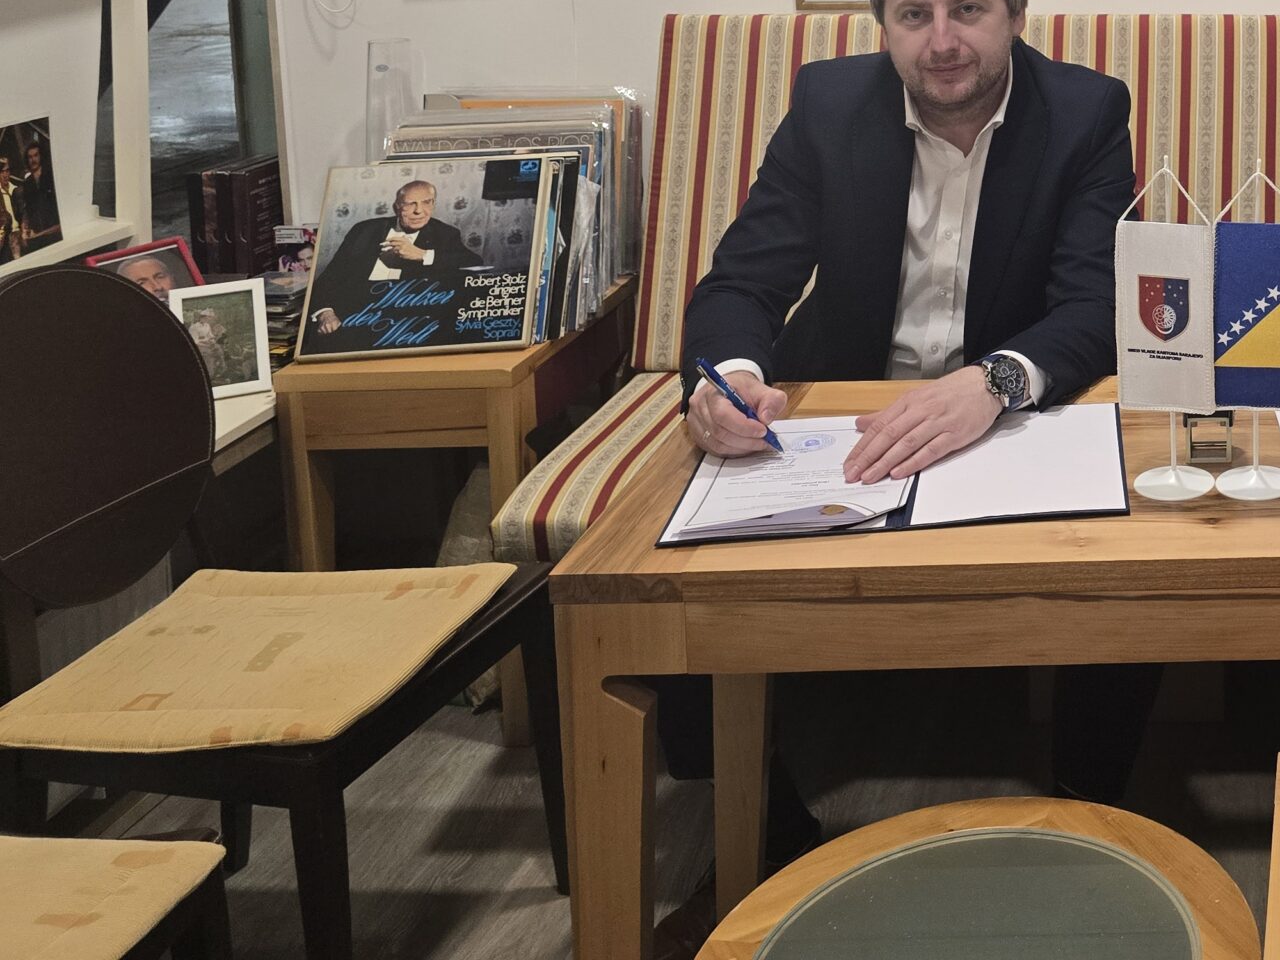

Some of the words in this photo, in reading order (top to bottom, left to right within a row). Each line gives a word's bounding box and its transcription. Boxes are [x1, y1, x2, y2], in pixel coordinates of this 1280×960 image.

[464, 275, 501, 288] Robert
[502, 273, 527, 285] Stolz
[370, 279, 455, 309] Walzer
[470, 297, 486, 308] die
[486, 295, 526, 308] Berliner
[342, 303, 382, 327] der
[457, 306, 524, 321] Symphoniker
[455, 320, 482, 333] Sylvia
[483, 328, 520, 340] Sopran
